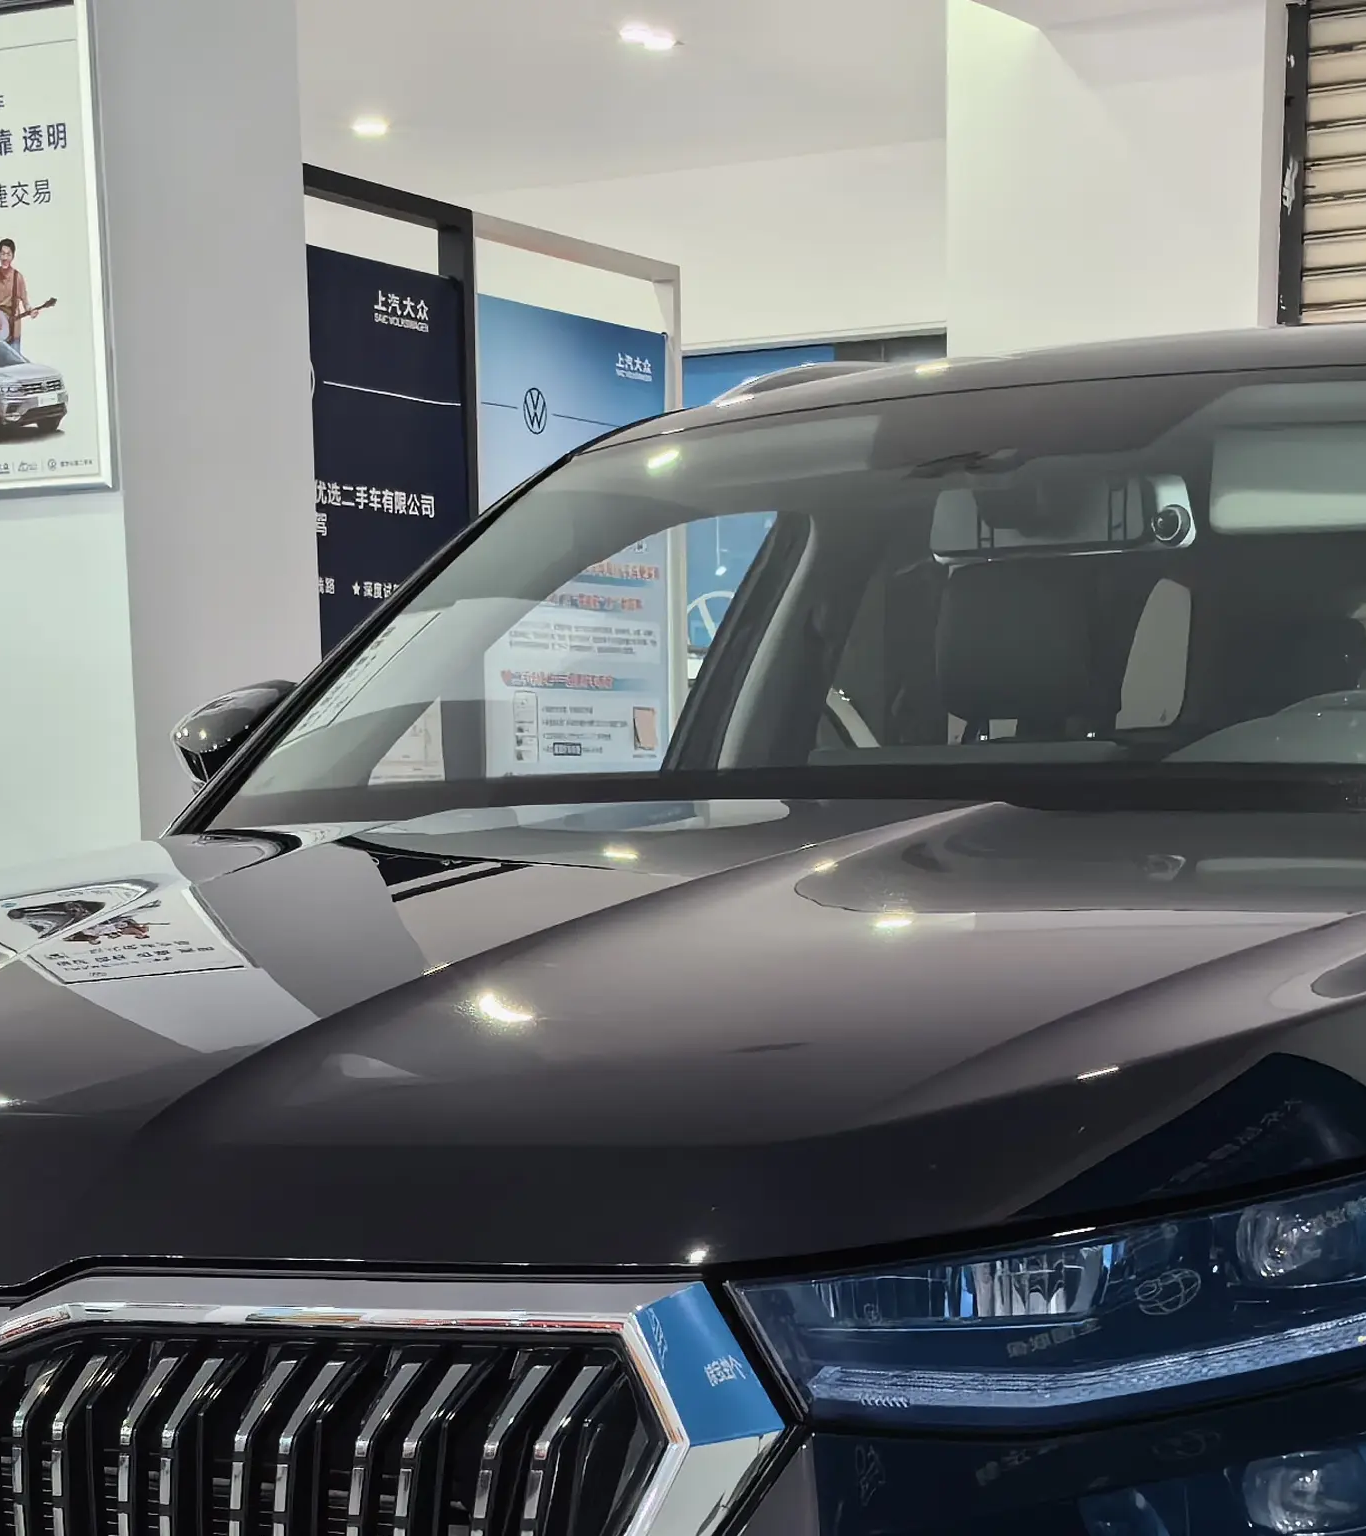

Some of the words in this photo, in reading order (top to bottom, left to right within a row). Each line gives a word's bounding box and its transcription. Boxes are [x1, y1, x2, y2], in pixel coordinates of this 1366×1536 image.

[22, 123, 67, 152] 透明
[374, 290, 429, 320] 上汽大众
[315, 479, 435, 518] 优选二手车有限公司
